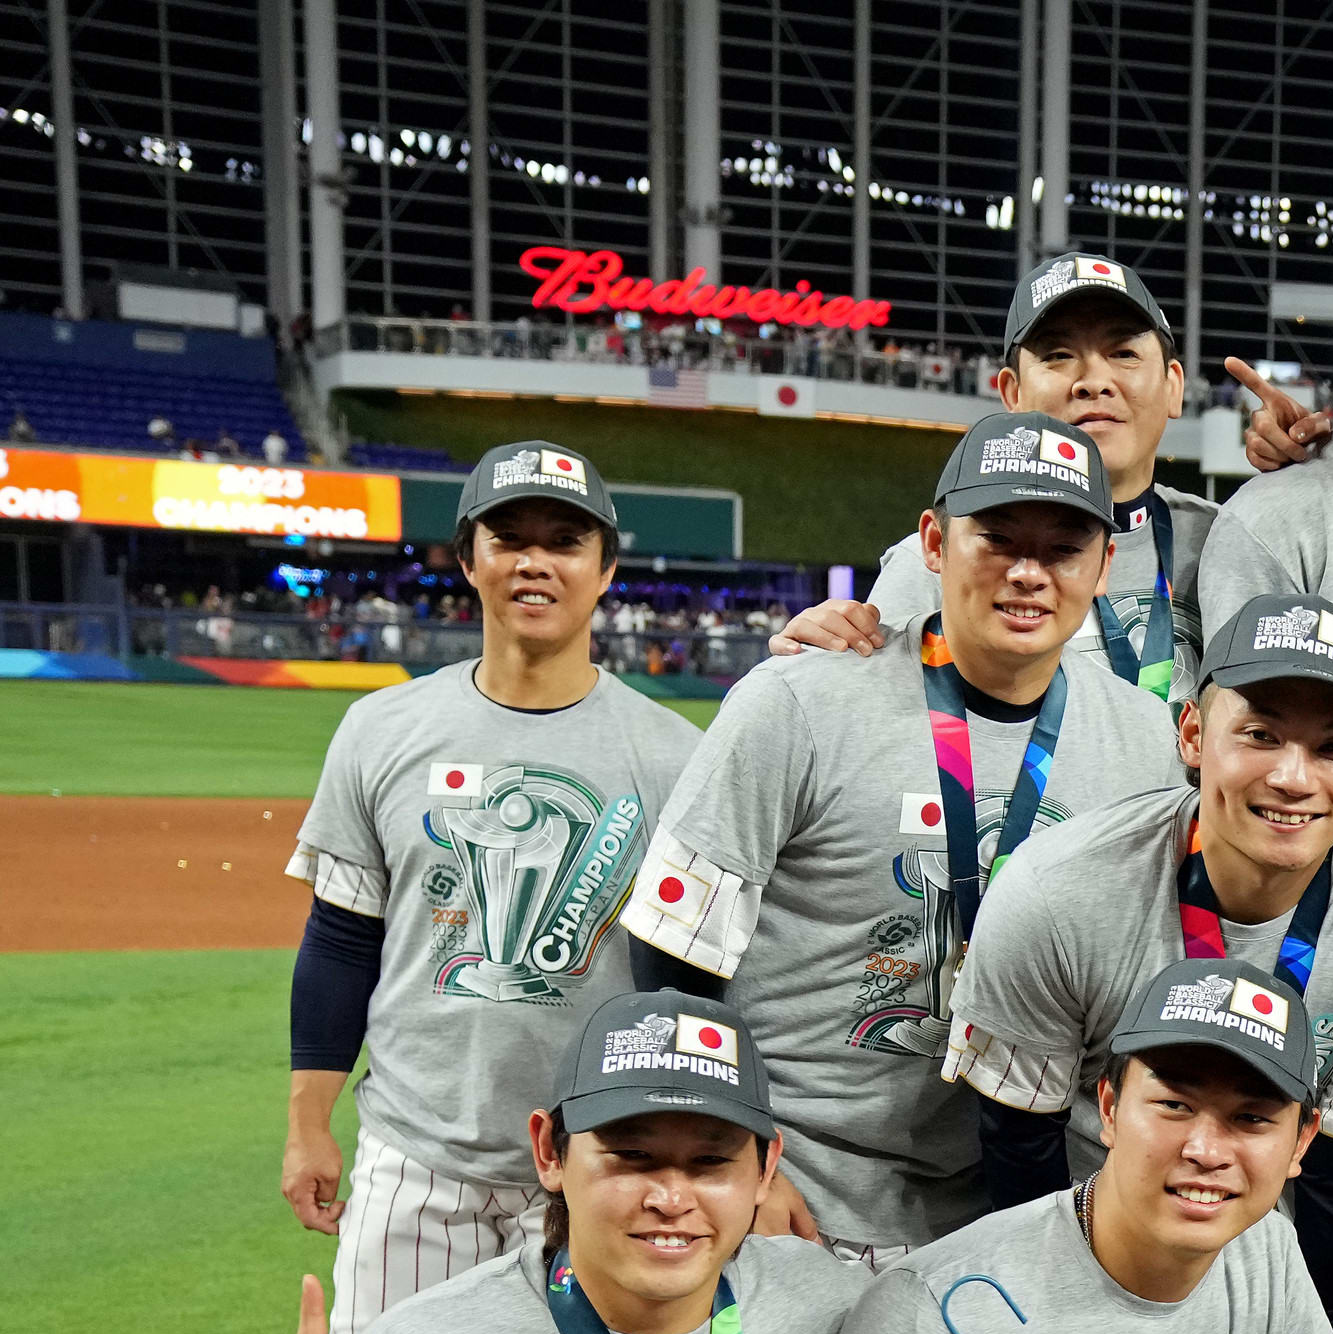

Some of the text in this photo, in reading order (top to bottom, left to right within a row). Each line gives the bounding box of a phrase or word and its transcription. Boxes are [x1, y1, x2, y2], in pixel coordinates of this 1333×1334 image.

[520, 246, 891, 330] Budweiser
[990, 445, 1032, 453] BASEBALL
[980, 459, 1090, 492] CHAMPIONS
[493, 474, 587, 496] CHAMPIONS
[152, 496, 368, 538] CHAMPIONS
[1257, 618, 1265, 635] 2023
[1265, 622, 1308, 633] BASEBALL
[1266, 616, 1298, 624] WORLD
[1264, 629, 1301, 638] CLASSIC
[532, 798, 641, 973] CHAMPIONS
[432, 908, 469, 925] 2023
[579, 880, 618, 941] JAPAN
[432, 924, 468, 938] 2023
[868, 916, 896, 937] WORLD
[866, 953, 921, 979] 2023
[1166, 986, 1177, 1006] 2023
[1175, 991, 1221, 1003] BASEBALL
[1178, 985, 1210, 994] WORLD
[1174, 999, 1213, 1008] CLASSIC
[614, 1030, 651, 1038] WORLD
[1160, 1006, 1285, 1051] CHAMPIONS
[613, 1045, 657, 1053] CLASSIC
[602, 1053, 740, 1085] CHAMPIONS
